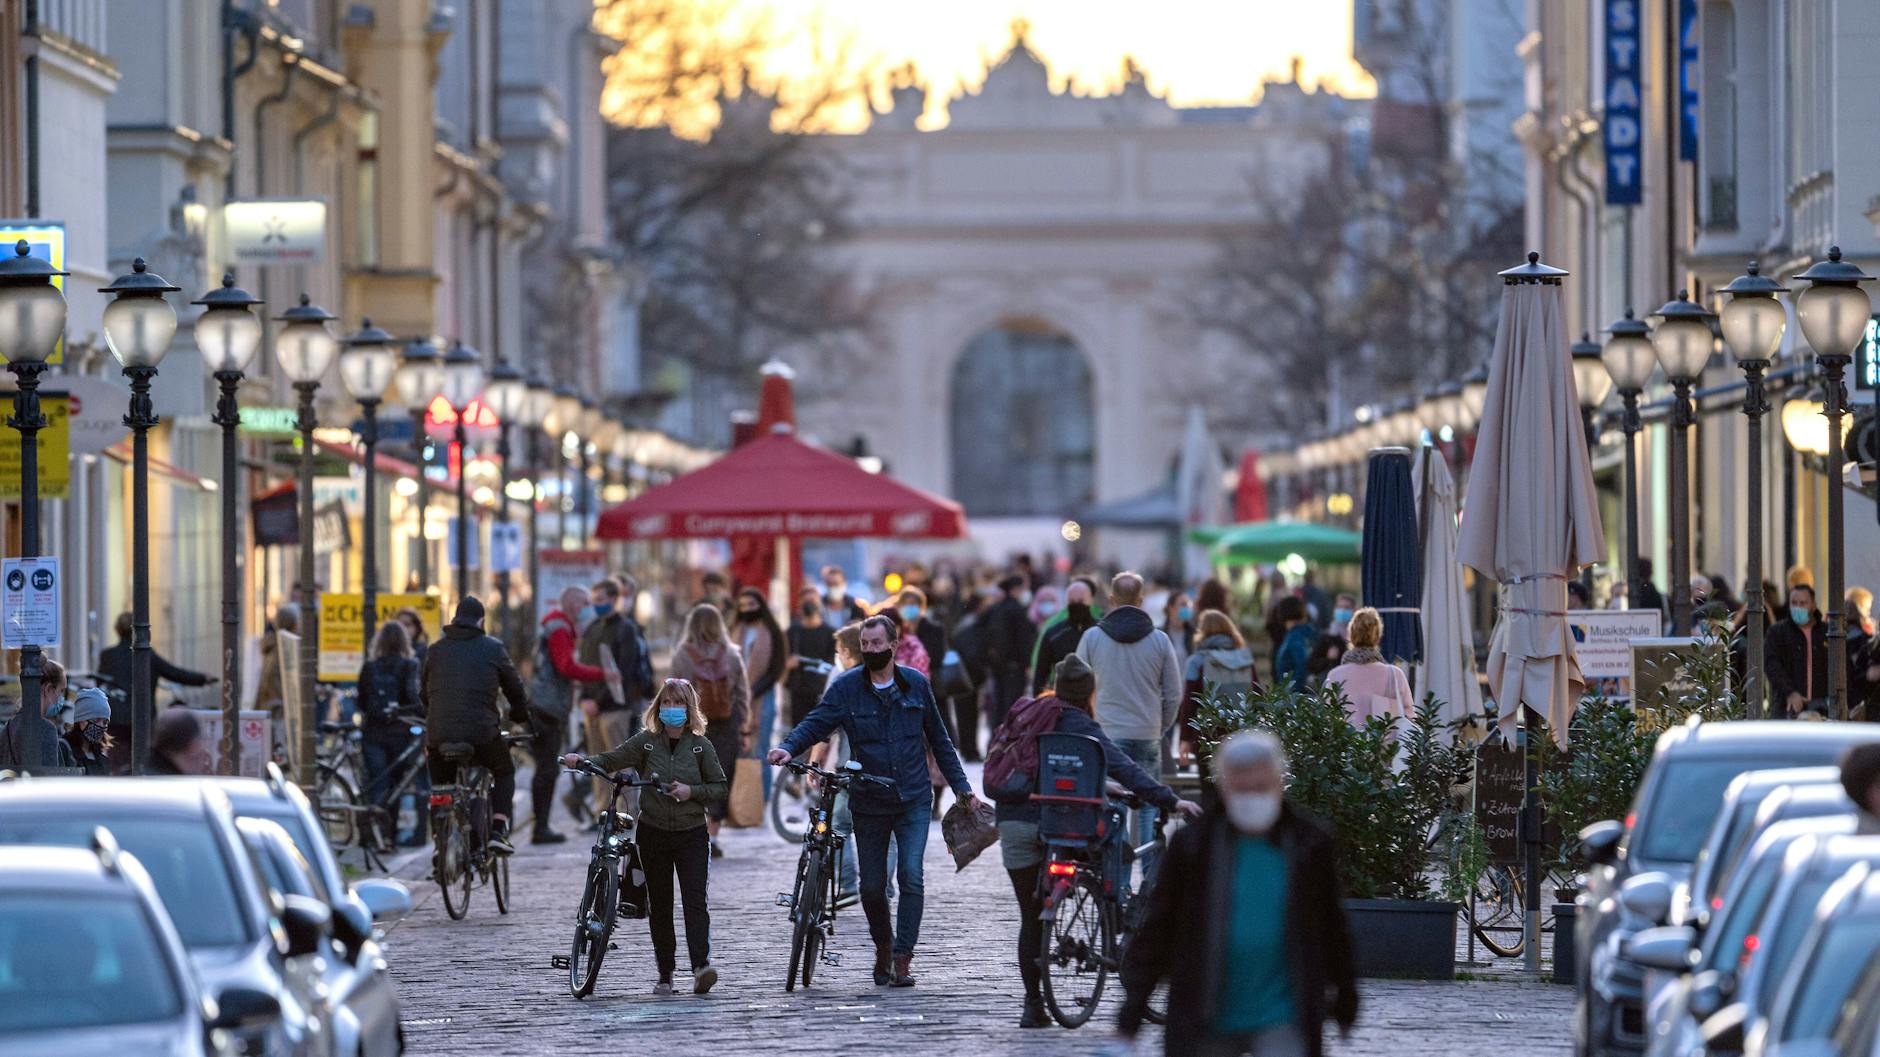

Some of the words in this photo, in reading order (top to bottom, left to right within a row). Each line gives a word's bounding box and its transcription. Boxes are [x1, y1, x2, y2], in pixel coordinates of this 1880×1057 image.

[1609, 1, 1639, 186] STADT
[686, 514, 784, 533] Currywurst
[1590, 624, 1650, 636] Musikschule
